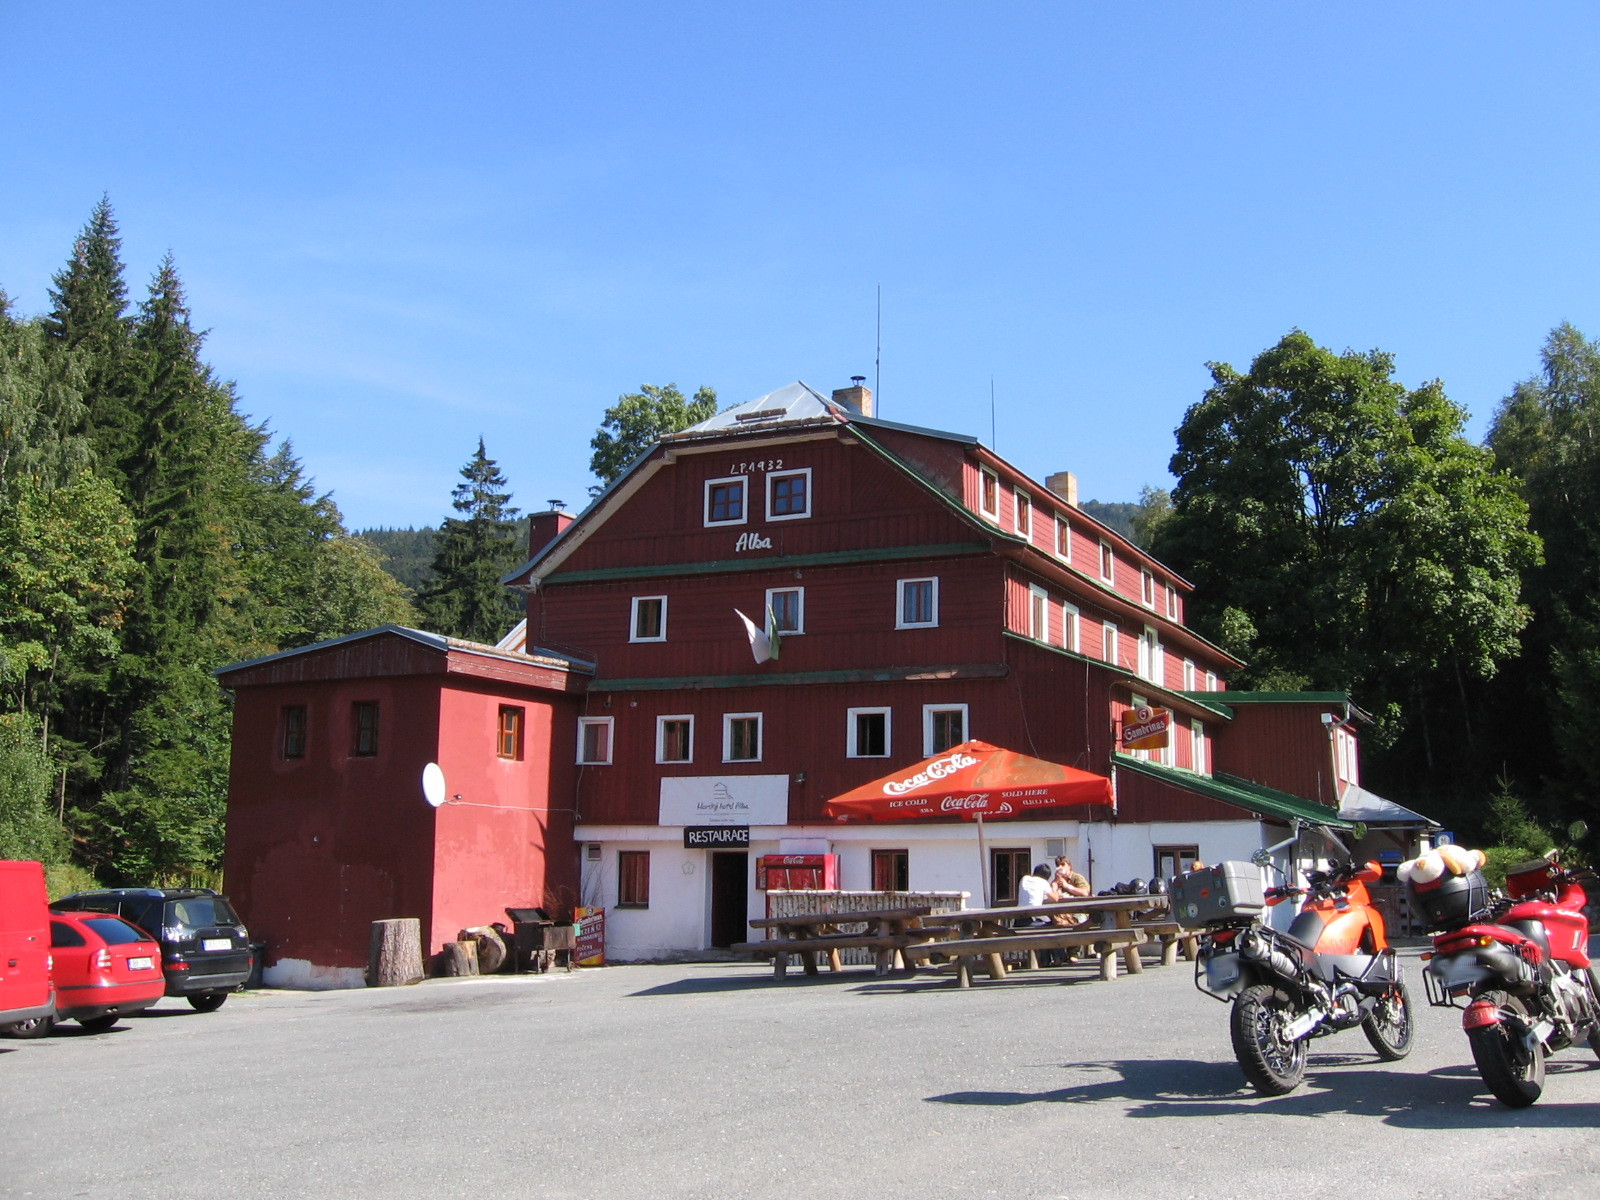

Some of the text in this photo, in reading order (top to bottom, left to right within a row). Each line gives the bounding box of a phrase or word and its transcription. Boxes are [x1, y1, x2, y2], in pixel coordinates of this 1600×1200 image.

[735, 532, 773, 552] Alba
[1124, 720, 1166, 741] Gambrinus
[883, 753, 981, 796] Coca-Cola
[1001, 788, 1049, 798] SOLD HERE
[889, 798, 928, 808] ICE COLD
[688, 829, 749, 844] RESTAURACE
